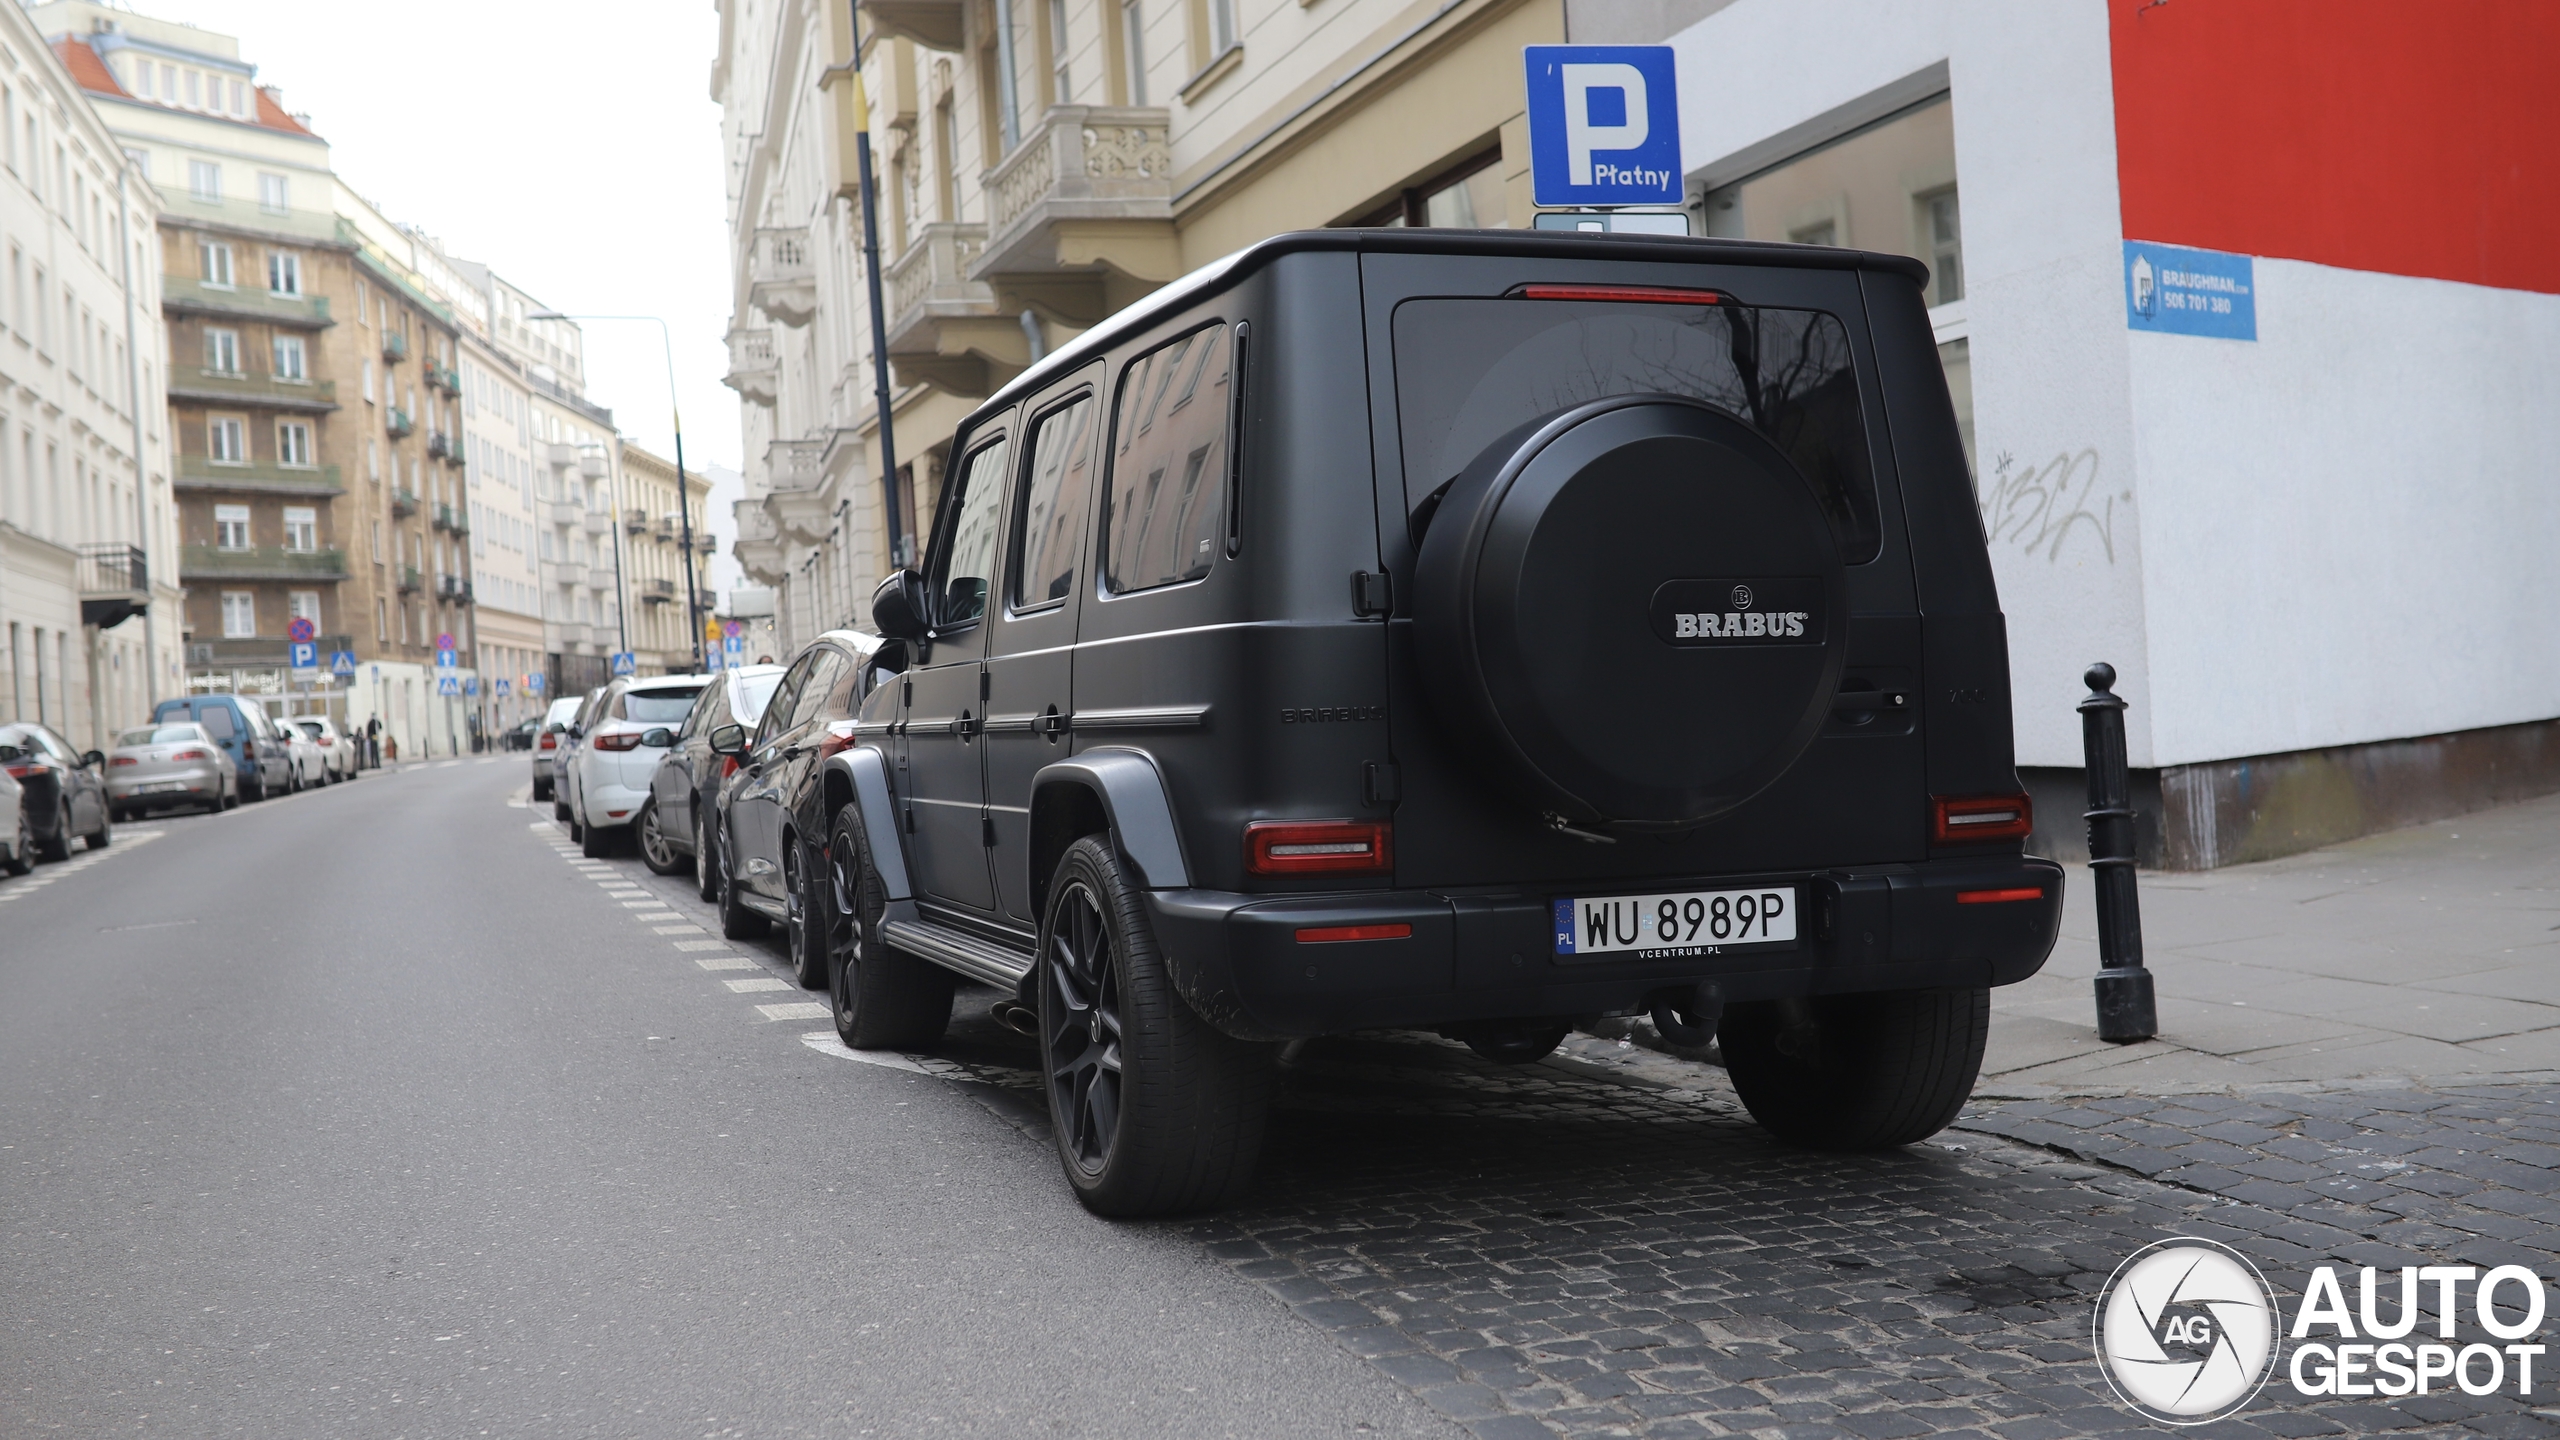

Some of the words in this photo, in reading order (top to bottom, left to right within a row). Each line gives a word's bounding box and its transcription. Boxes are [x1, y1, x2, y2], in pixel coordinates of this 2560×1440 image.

[1562, 63, 1649, 186] P
[1595, 164, 1671, 192] Płatny
[2165, 293, 2185, 310] 506
[2188, 295, 2207, 312] 701
[2211, 297, 2231, 314] 380
[295, 644, 313, 667] P
[1281, 706, 1386, 724] BRABUS
[1558, 932, 1573, 946] PL
[1585, 900, 1639, 948] WU
[1657, 893, 1784, 942] 8989P
[1638, 946, 1721, 959] VCENTRUM.PL
